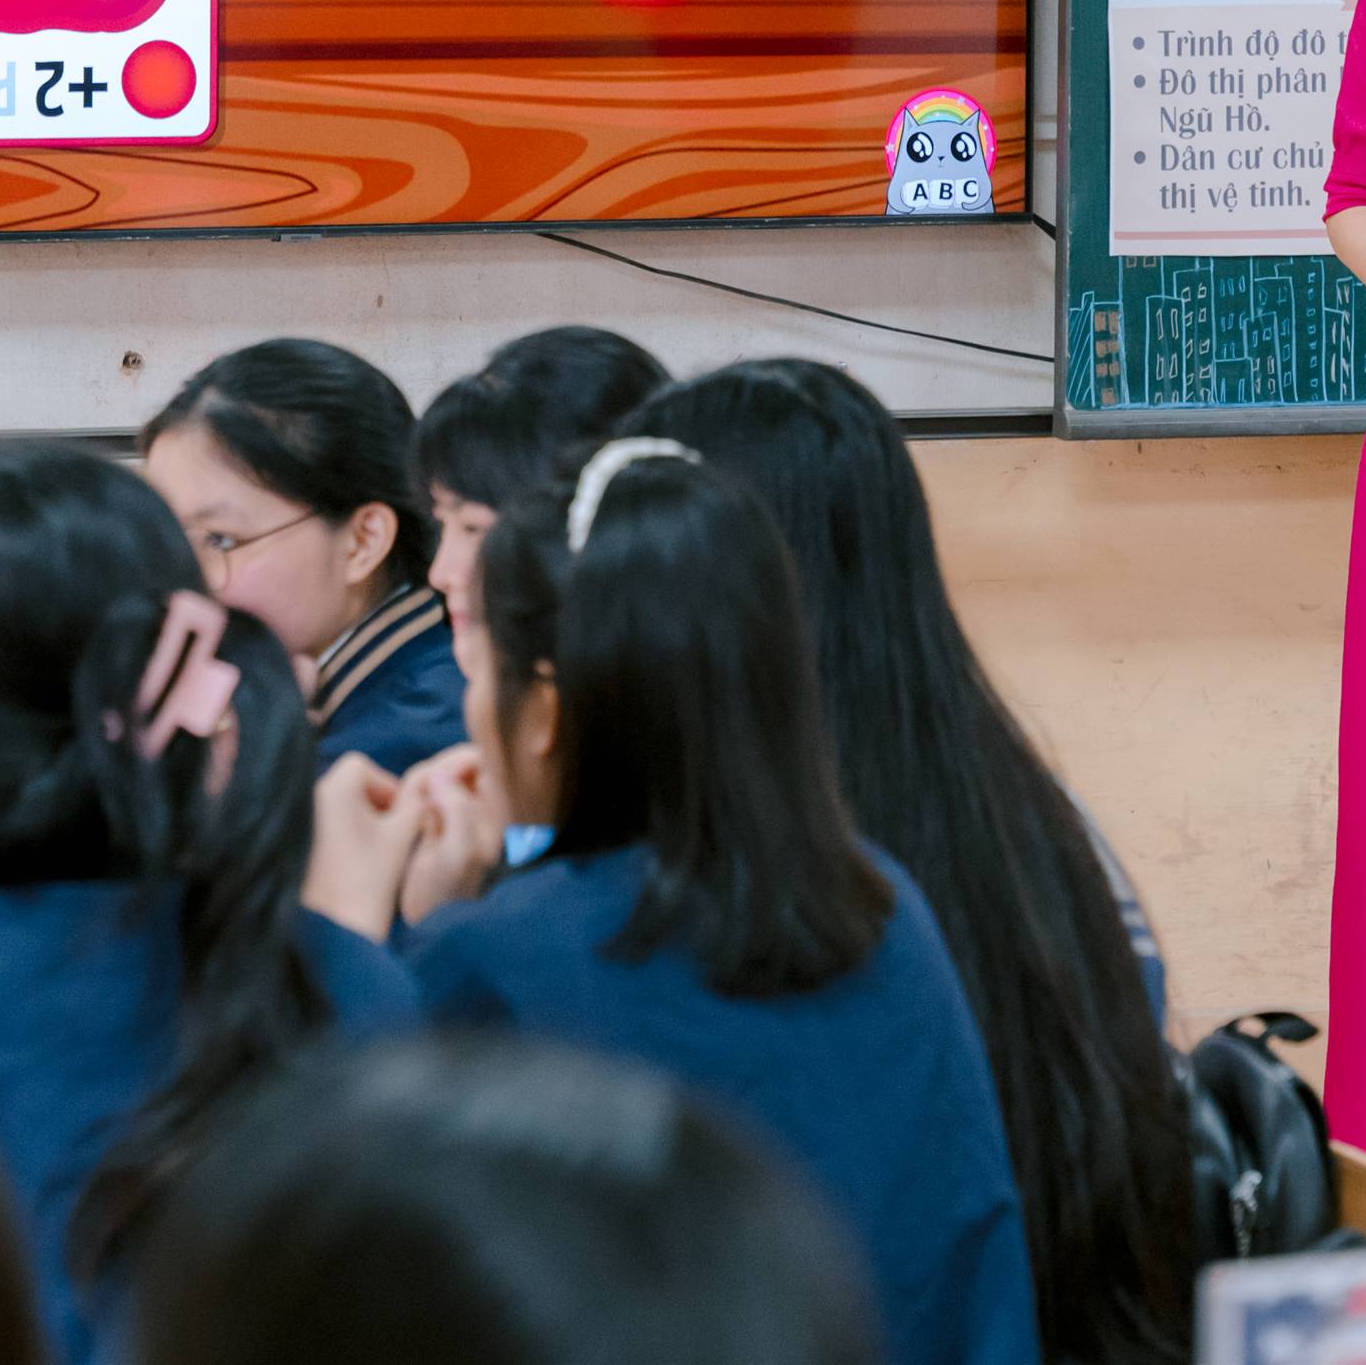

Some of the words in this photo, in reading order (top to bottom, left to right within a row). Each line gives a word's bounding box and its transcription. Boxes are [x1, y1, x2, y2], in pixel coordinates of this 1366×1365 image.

[1158, 29, 1233, 57] Trình
[1245, 29, 1280, 61] độ
[1291, 28, 1326, 56] đô
[35, 61, 108, 117] +2
[1159, 68, 1196, 96] Đô
[1209, 67, 1244, 98] thị
[1257, 67, 1327, 99] phân
[1159, 106, 1213, 139] Ngũ
[1225, 102, 1270, 132] Hồ.
[1160, 143, 1215, 171] Dân
[1227, 146, 1263, 170] cư
[1273, 141, 1324, 169] chủ
[1160, 182, 1196, 213] thị
[1207, 182, 1239, 213] vệ
[1249, 180, 1311, 207] tinh.
